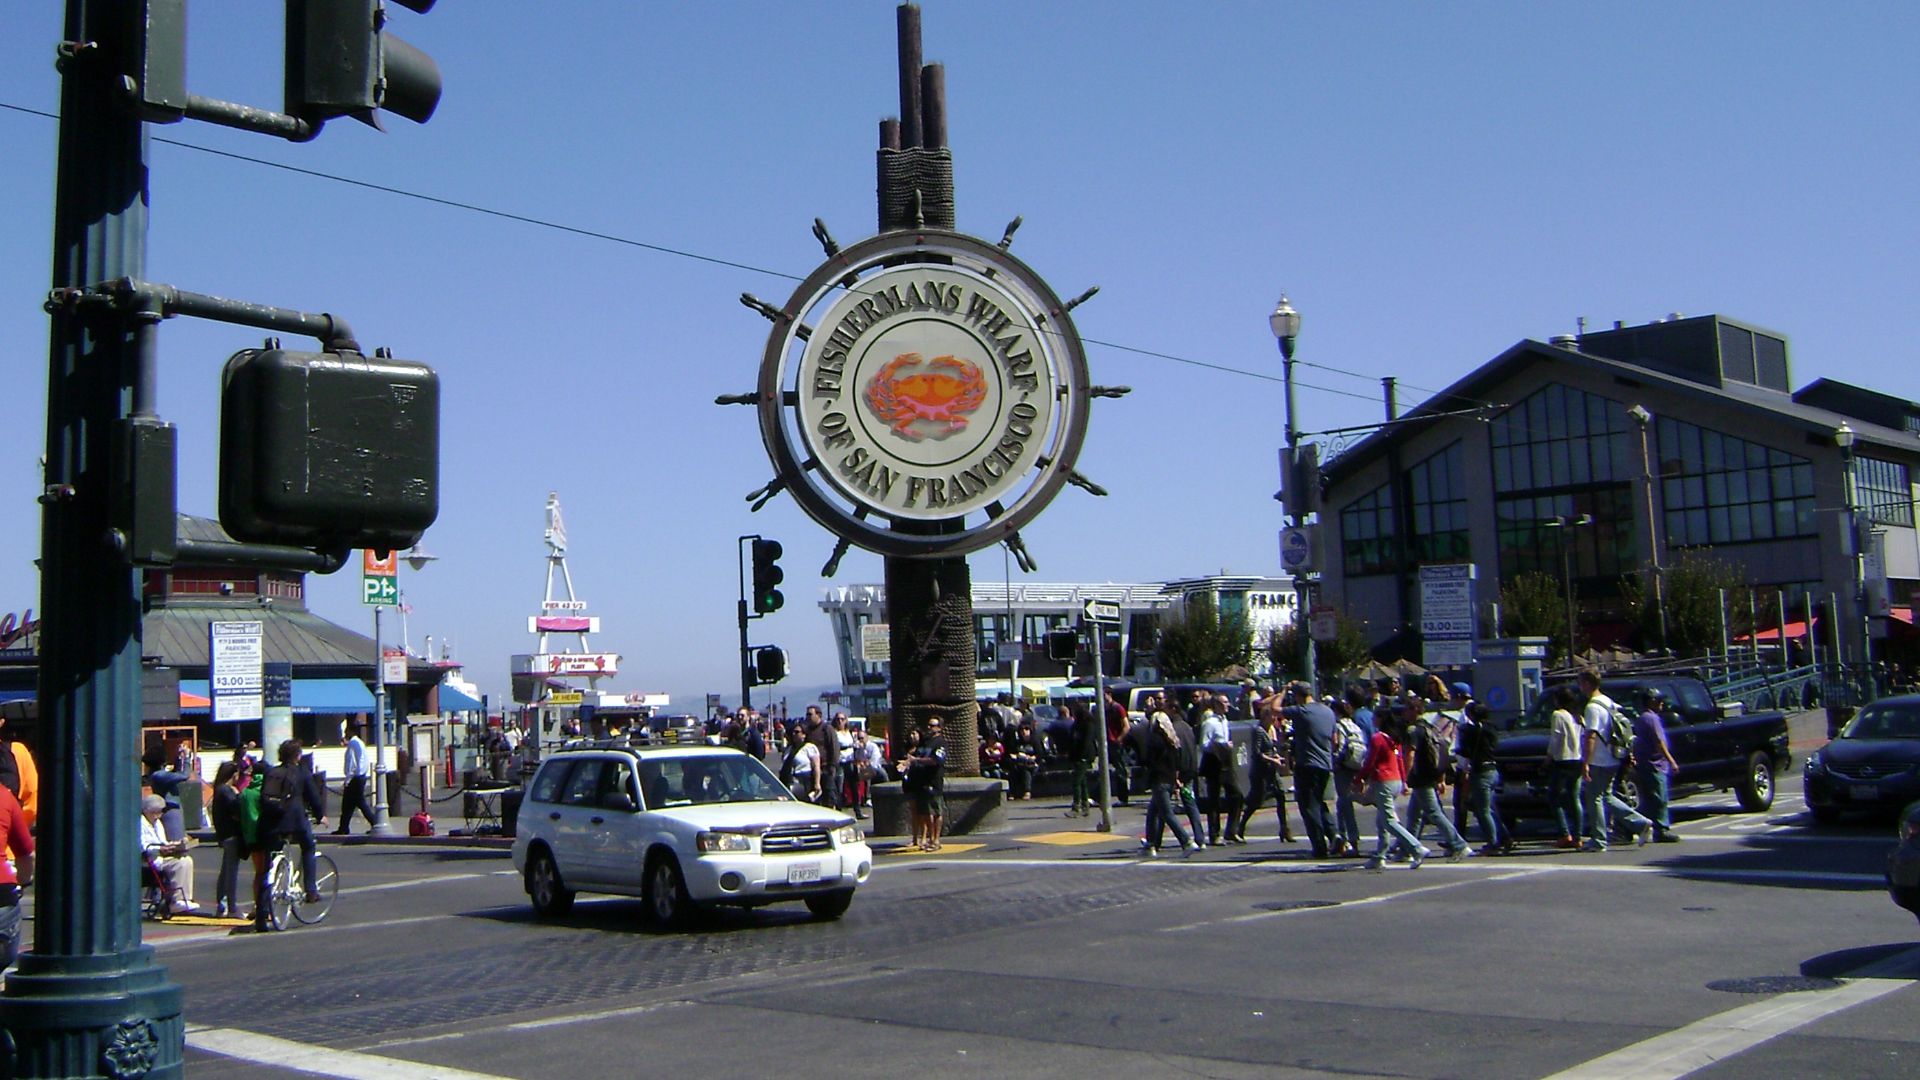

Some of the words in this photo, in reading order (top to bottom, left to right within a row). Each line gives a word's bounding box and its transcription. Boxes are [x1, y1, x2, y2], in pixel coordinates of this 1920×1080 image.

[814, 280, 963, 400] FISHERMANS
[963, 290, 1039, 393] WHARF
[818, 410, 856, 449] OF
[839, 446, 900, 501] SAN
[902, 401, 1038, 509] FRANCISCO
[1095, 605, 1105, 615] ONE
[1106, 606, 1117, 616] WAY
[217, 676, 244, 686] $3.00
